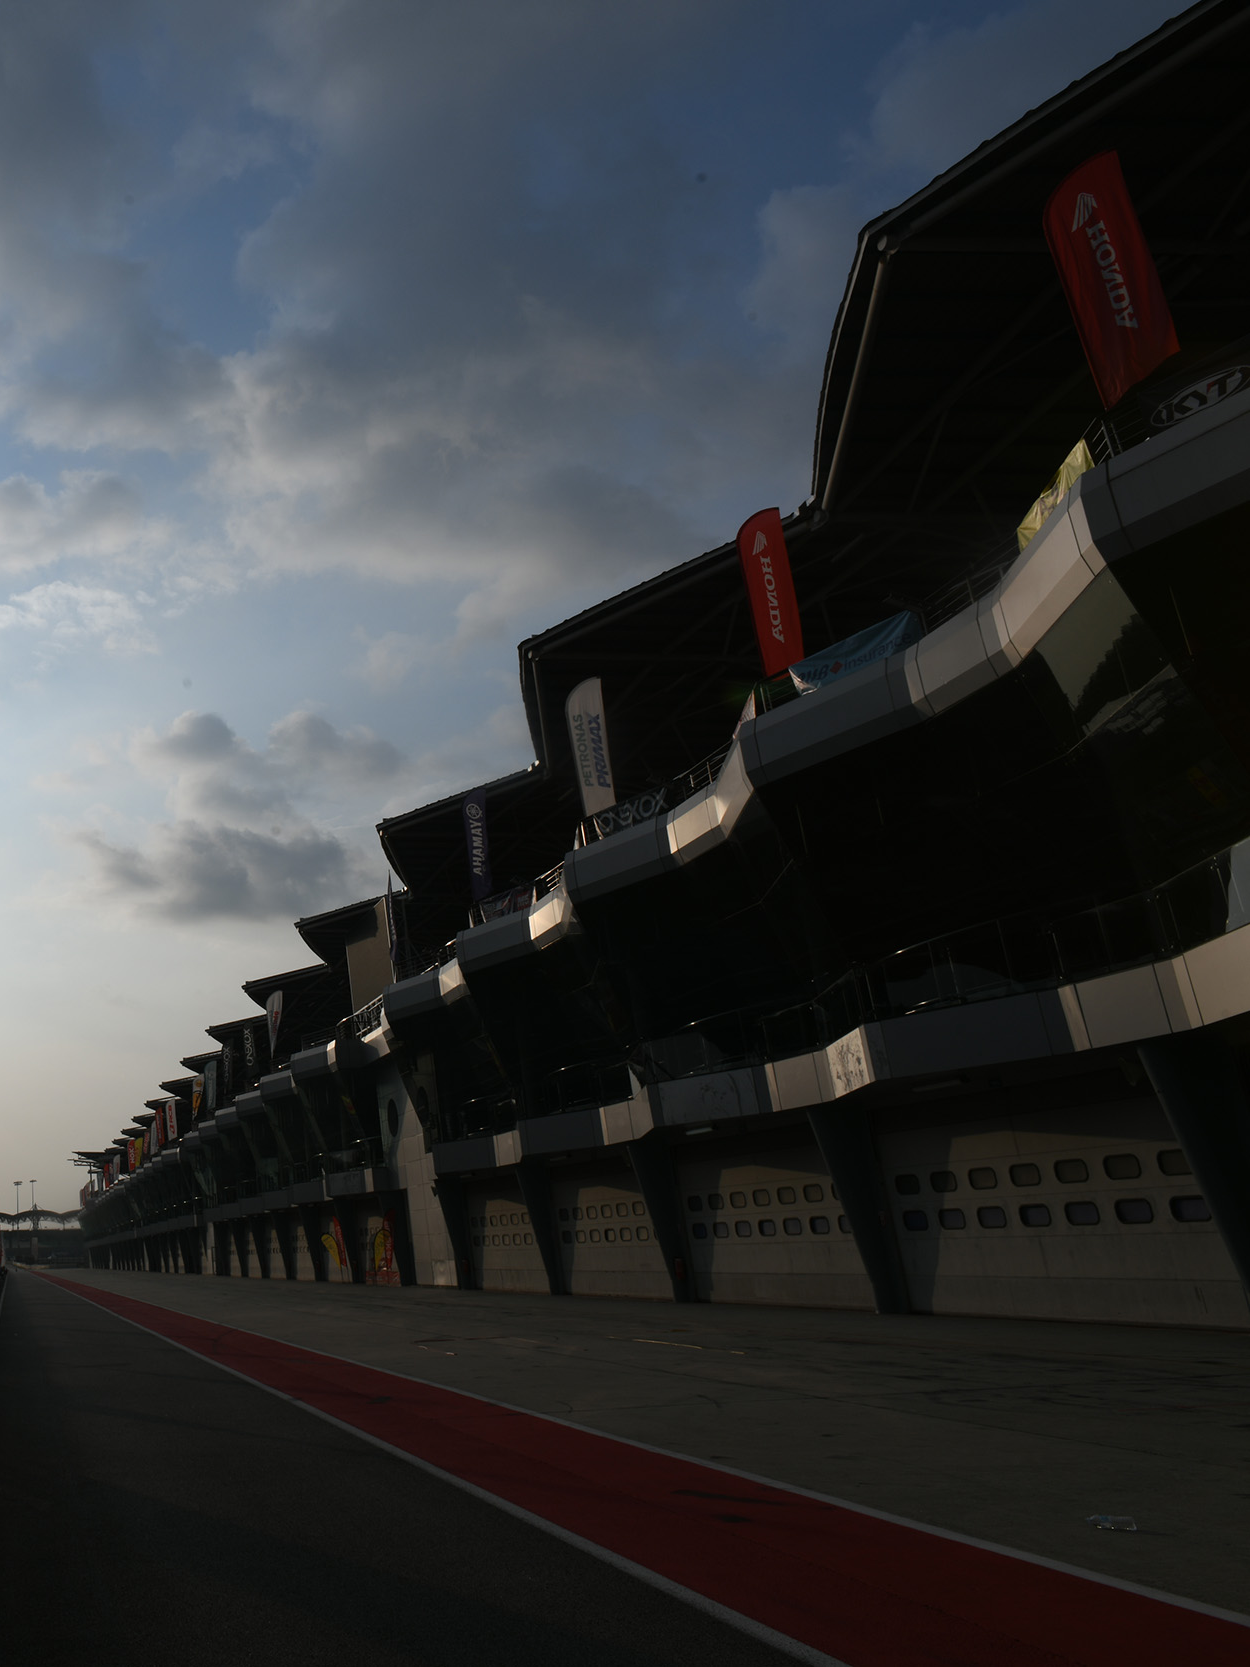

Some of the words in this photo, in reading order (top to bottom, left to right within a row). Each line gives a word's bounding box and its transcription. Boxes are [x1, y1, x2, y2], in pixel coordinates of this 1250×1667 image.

[1159, 370, 1237, 424] KYT
[844, 632, 912, 672] insurance
[573, 714, 594, 787] PETRONAS
[586, 712, 611, 788] PRIMAX
